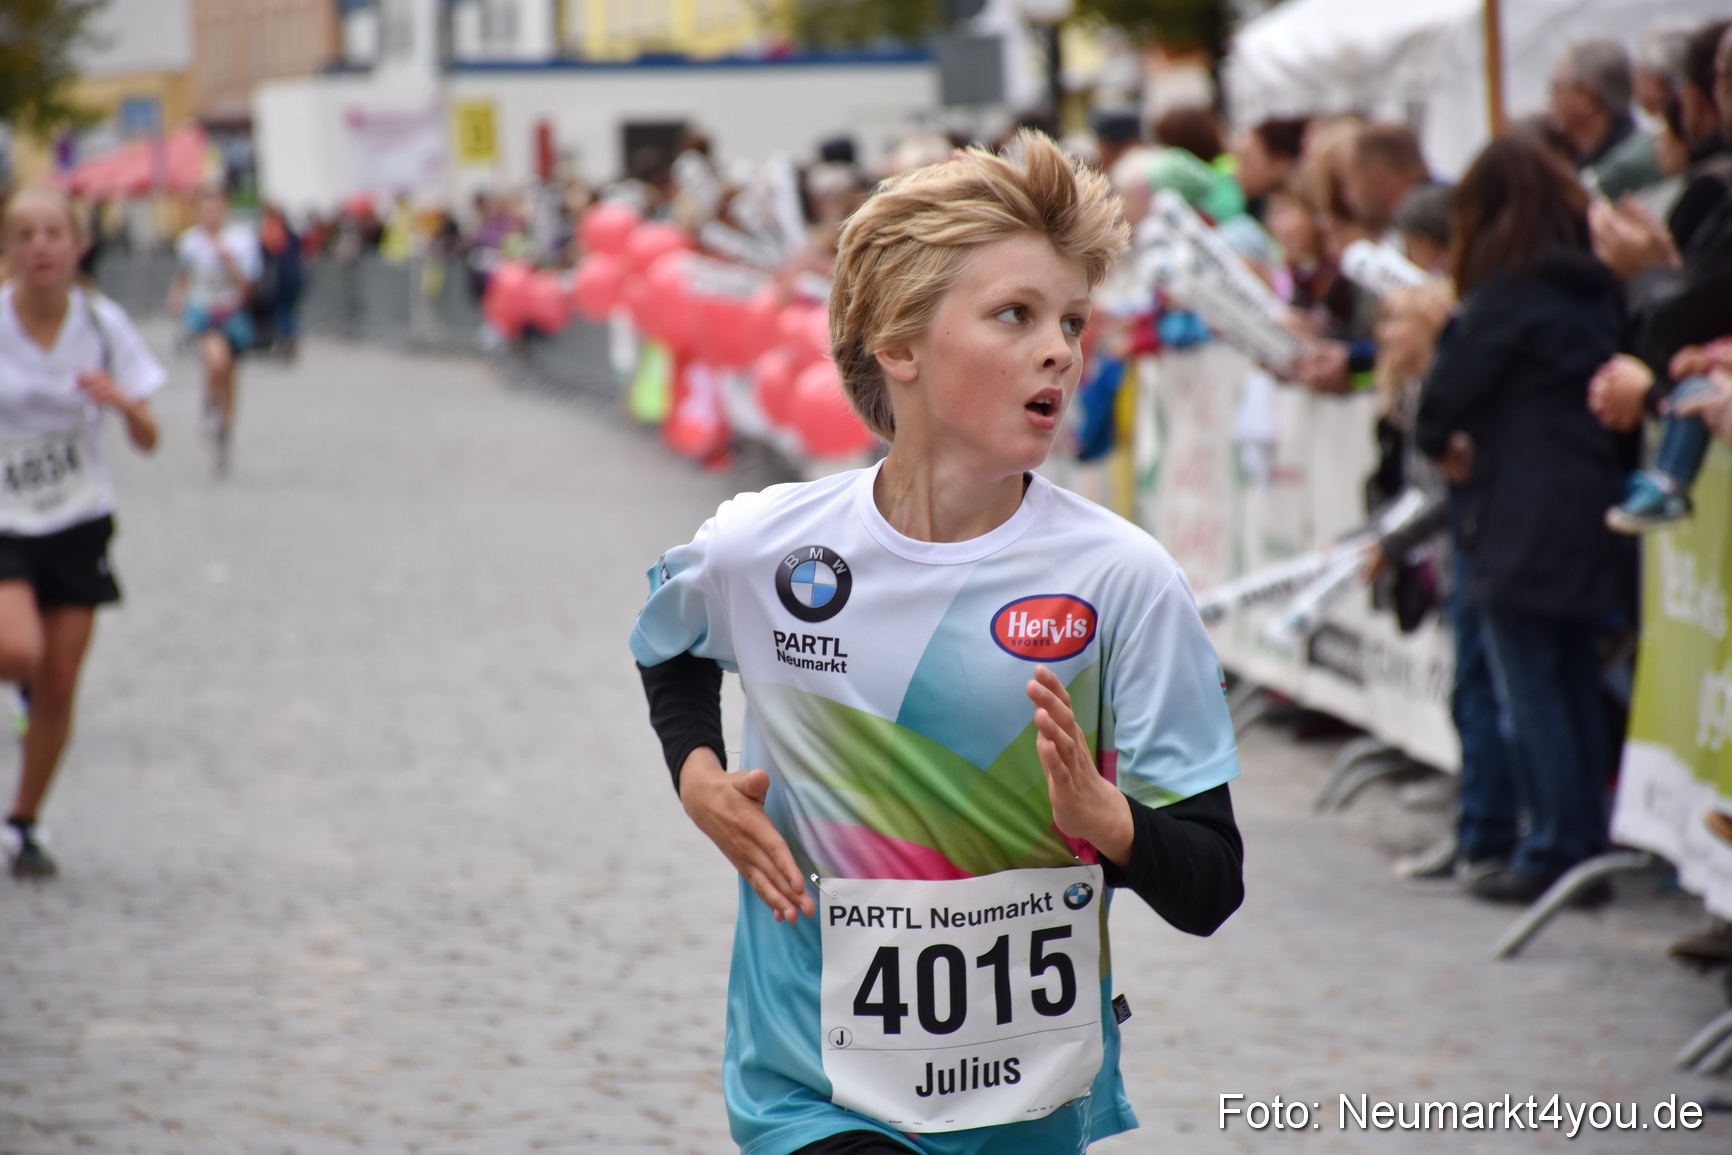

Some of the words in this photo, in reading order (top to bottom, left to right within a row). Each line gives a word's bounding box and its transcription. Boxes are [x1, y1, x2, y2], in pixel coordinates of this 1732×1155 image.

[784, 547, 848, 575] BMW
[1007, 611, 1088, 644] Hervis
[773, 630, 848, 658] PARTL
[1011, 639, 1051, 647] SPORTS
[776, 648, 847, 673] Neumarkt
[829, 905, 922, 929] PARTL
[930, 892, 1053, 928] Neumarkt
[853, 924, 1077, 1035] 4015
[836, 1030, 845, 1046] J
[915, 1056, 1021, 1097] Julius
